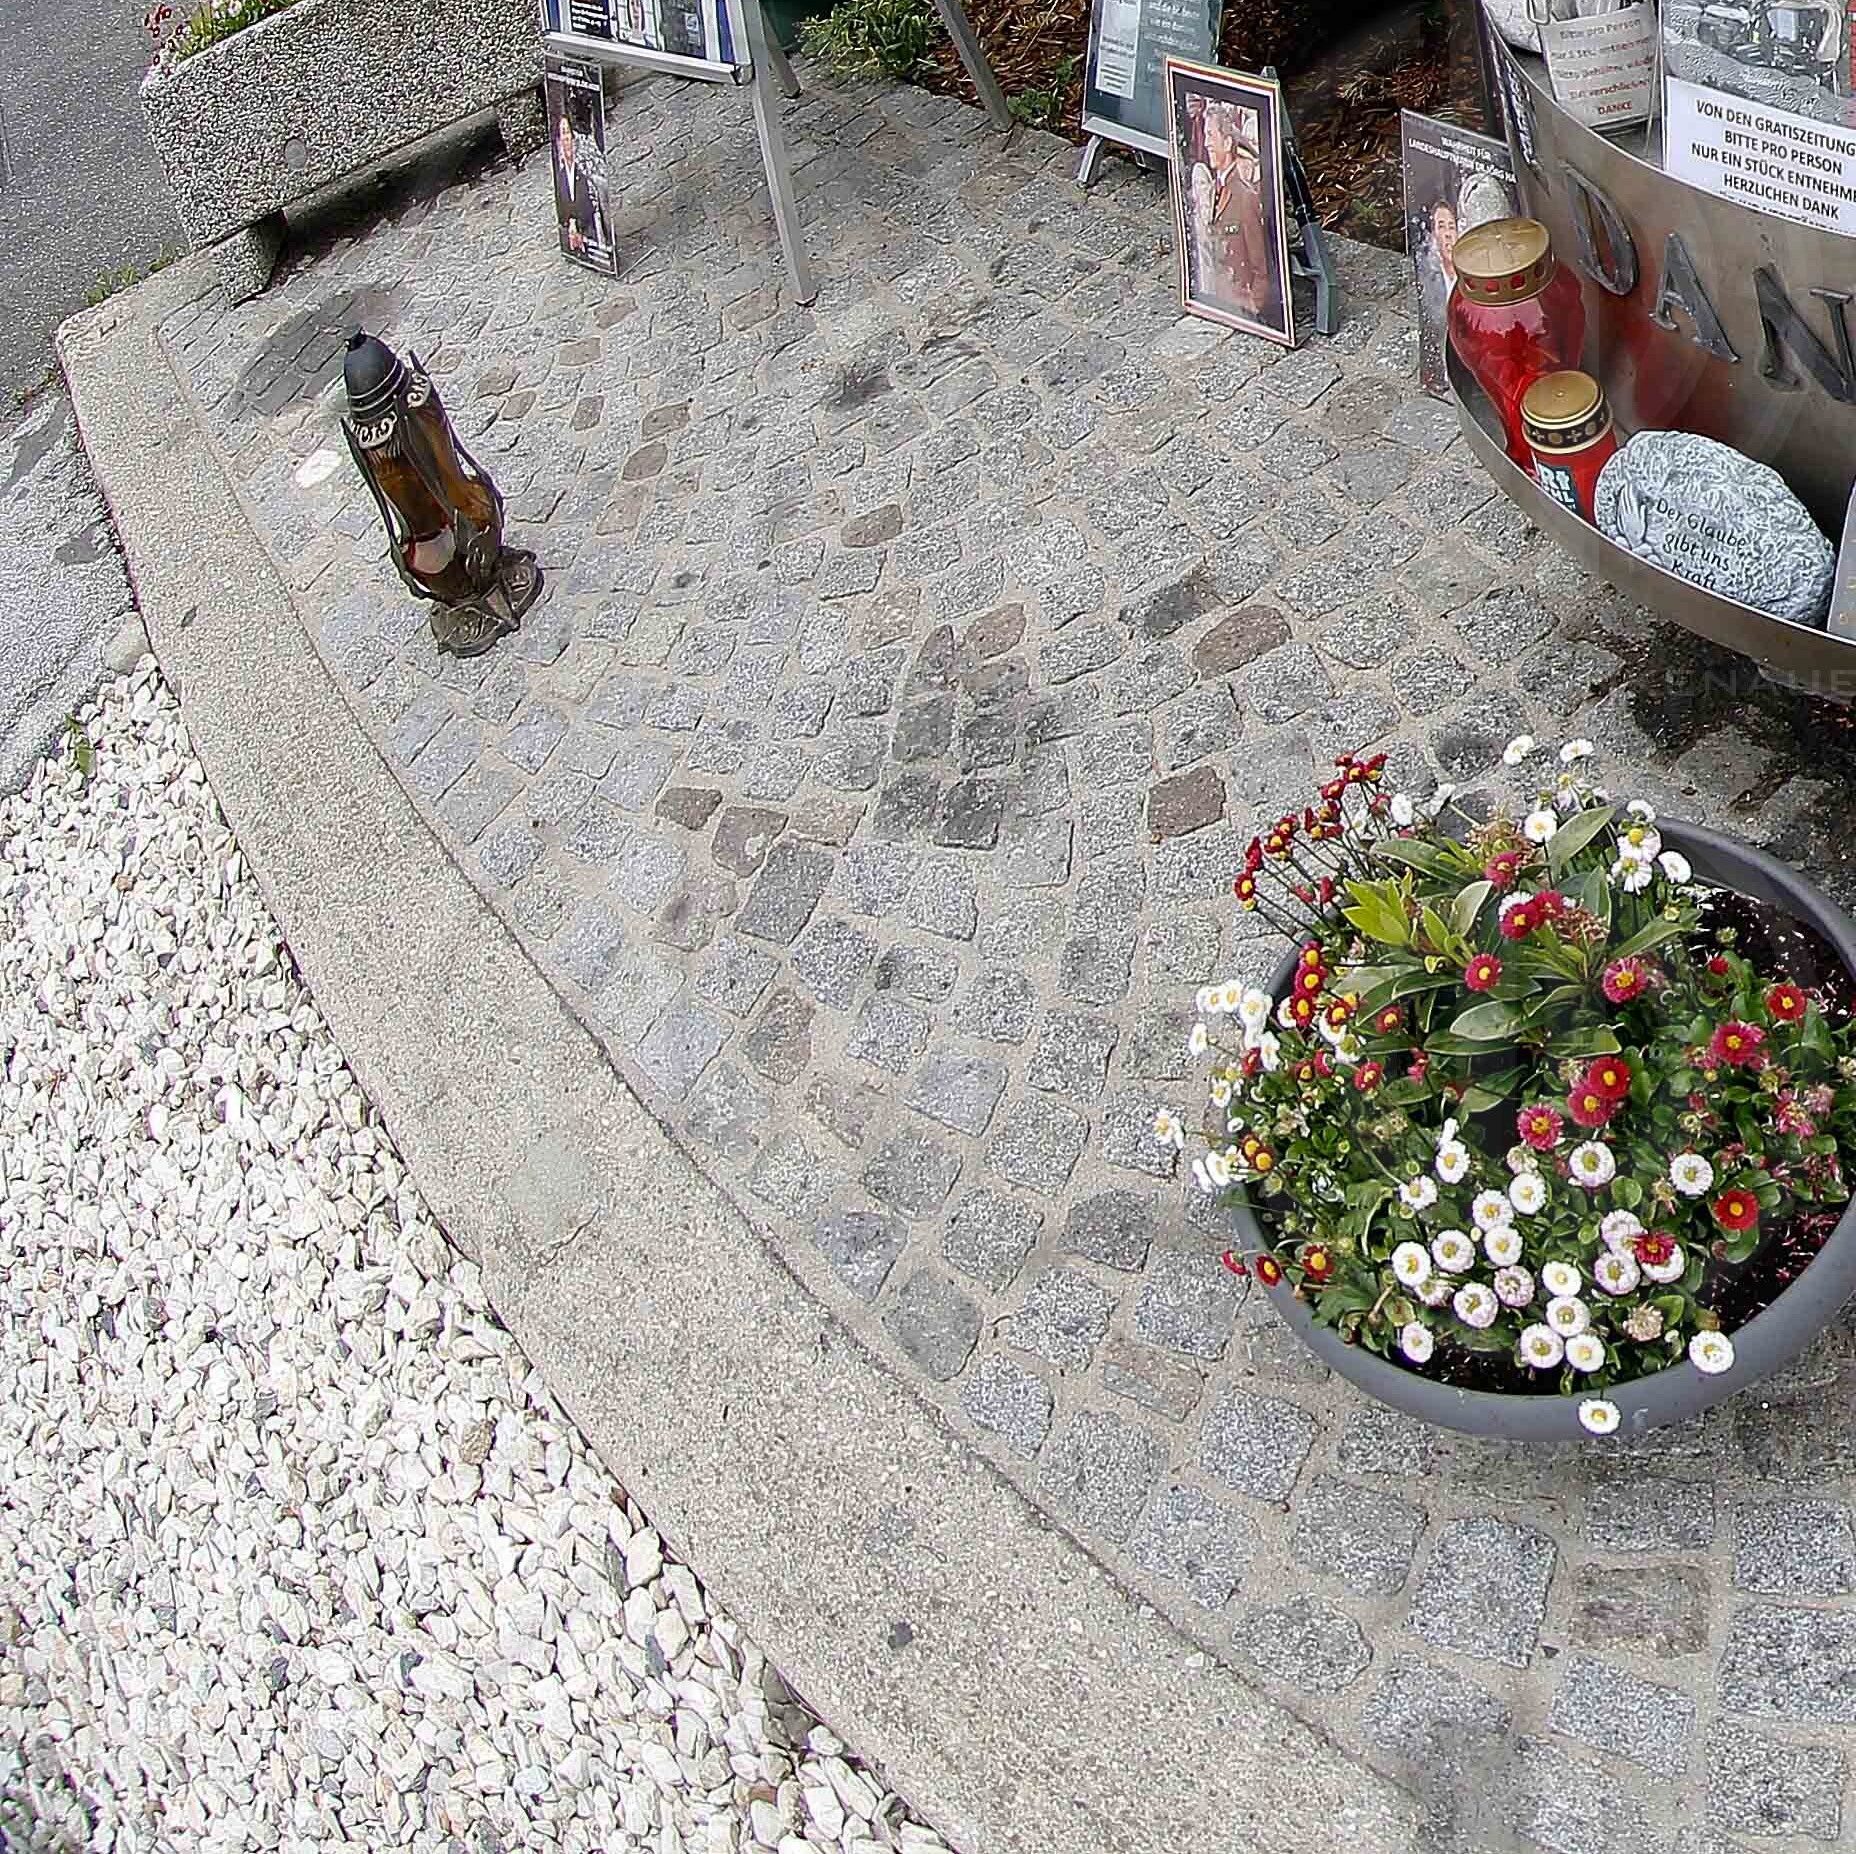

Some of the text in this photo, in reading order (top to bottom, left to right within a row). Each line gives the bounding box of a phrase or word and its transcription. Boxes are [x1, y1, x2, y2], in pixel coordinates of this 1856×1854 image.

[1598, 100, 1633, 115] DANKE
[1695, 98, 1723, 120] VON
[1726, 108, 1752, 127] DEN
[1691, 142, 1719, 162] NUR
[1721, 151, 1743, 168] EIN
[1744, 158, 1785, 182] STÜCK
[1724, 129, 1843, 177] BITTE PRO PERSON
[1723, 173, 1800, 208] HERZLICHEN
[1802, 197, 1840, 221] DANK
[1655, 497, 1748, 549] Der Glaube
[1670, 559, 1718, 590] Kraft
[1700, 548, 1731, 572] uns
